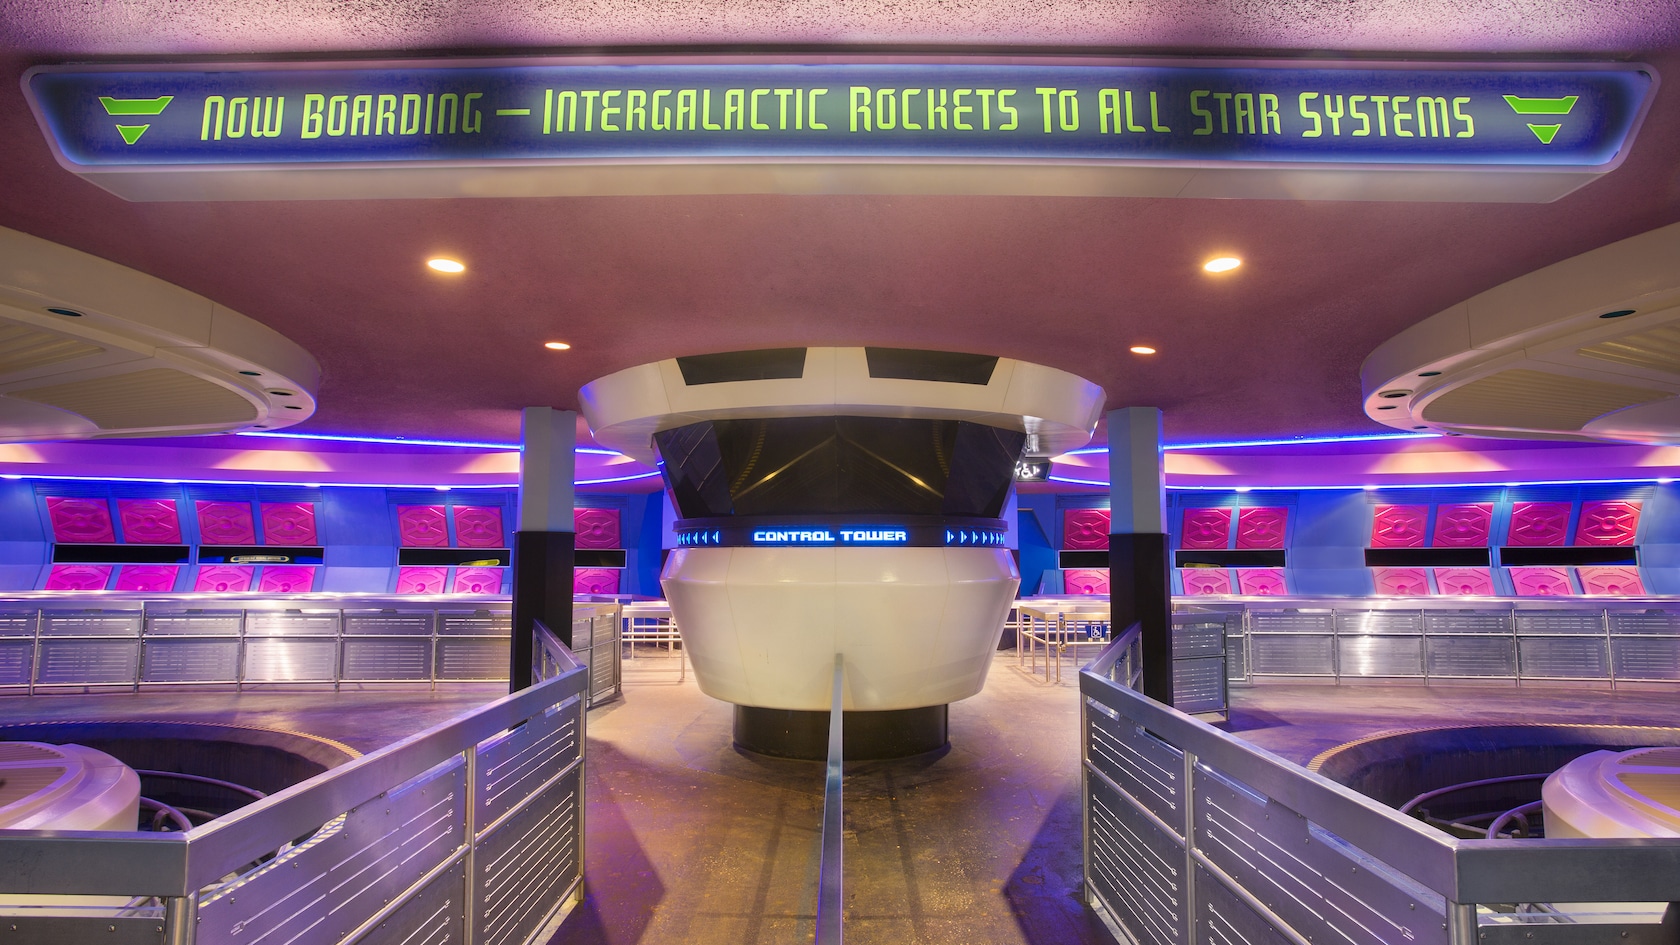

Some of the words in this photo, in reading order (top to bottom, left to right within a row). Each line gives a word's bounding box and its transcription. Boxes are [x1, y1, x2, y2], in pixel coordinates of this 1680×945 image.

[201, 96, 285, 141] NOW
[302, 93, 483, 139] BOARDING
[543, 89, 829, 134] INTERGALACTIC
[849, 86, 1019, 132] ROCKETS
[1035, 88, 1080, 133] TO
[1098, 88, 1171, 134] ALL
[1191, 91, 1281, 135] STAR
[1299, 92, 1475, 138] SYSTEMS
[753, 531, 835, 542] CONTROL
[840, 531, 907, 542] TOWER
